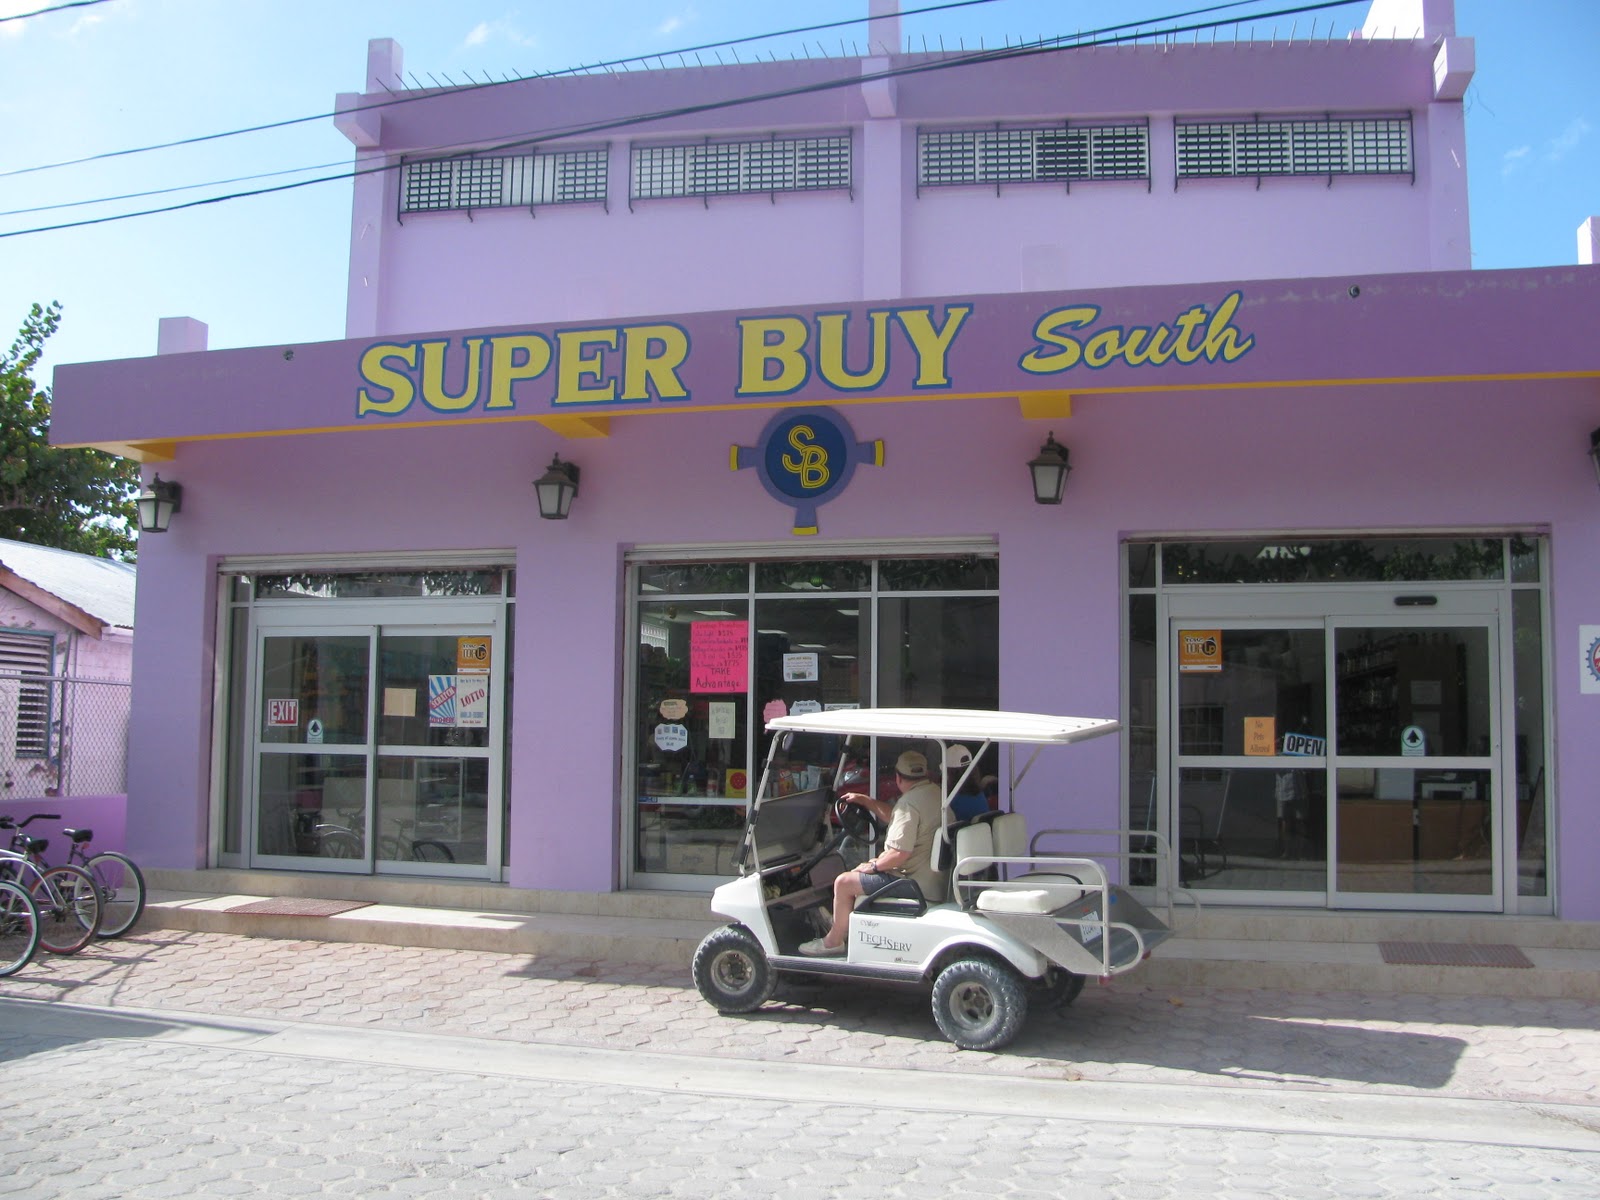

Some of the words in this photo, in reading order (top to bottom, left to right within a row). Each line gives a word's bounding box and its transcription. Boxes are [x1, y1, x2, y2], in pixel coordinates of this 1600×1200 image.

[356, 323, 692, 418] SUPER
[736, 303, 974, 397] BUY
[1018, 290, 1256, 375] South
[431, 686, 455, 708] SCRATCH
[460, 688, 485, 708] LOTTO
[271, 701, 296, 721] EXIT
[1286, 735, 1323, 756] OPEN
